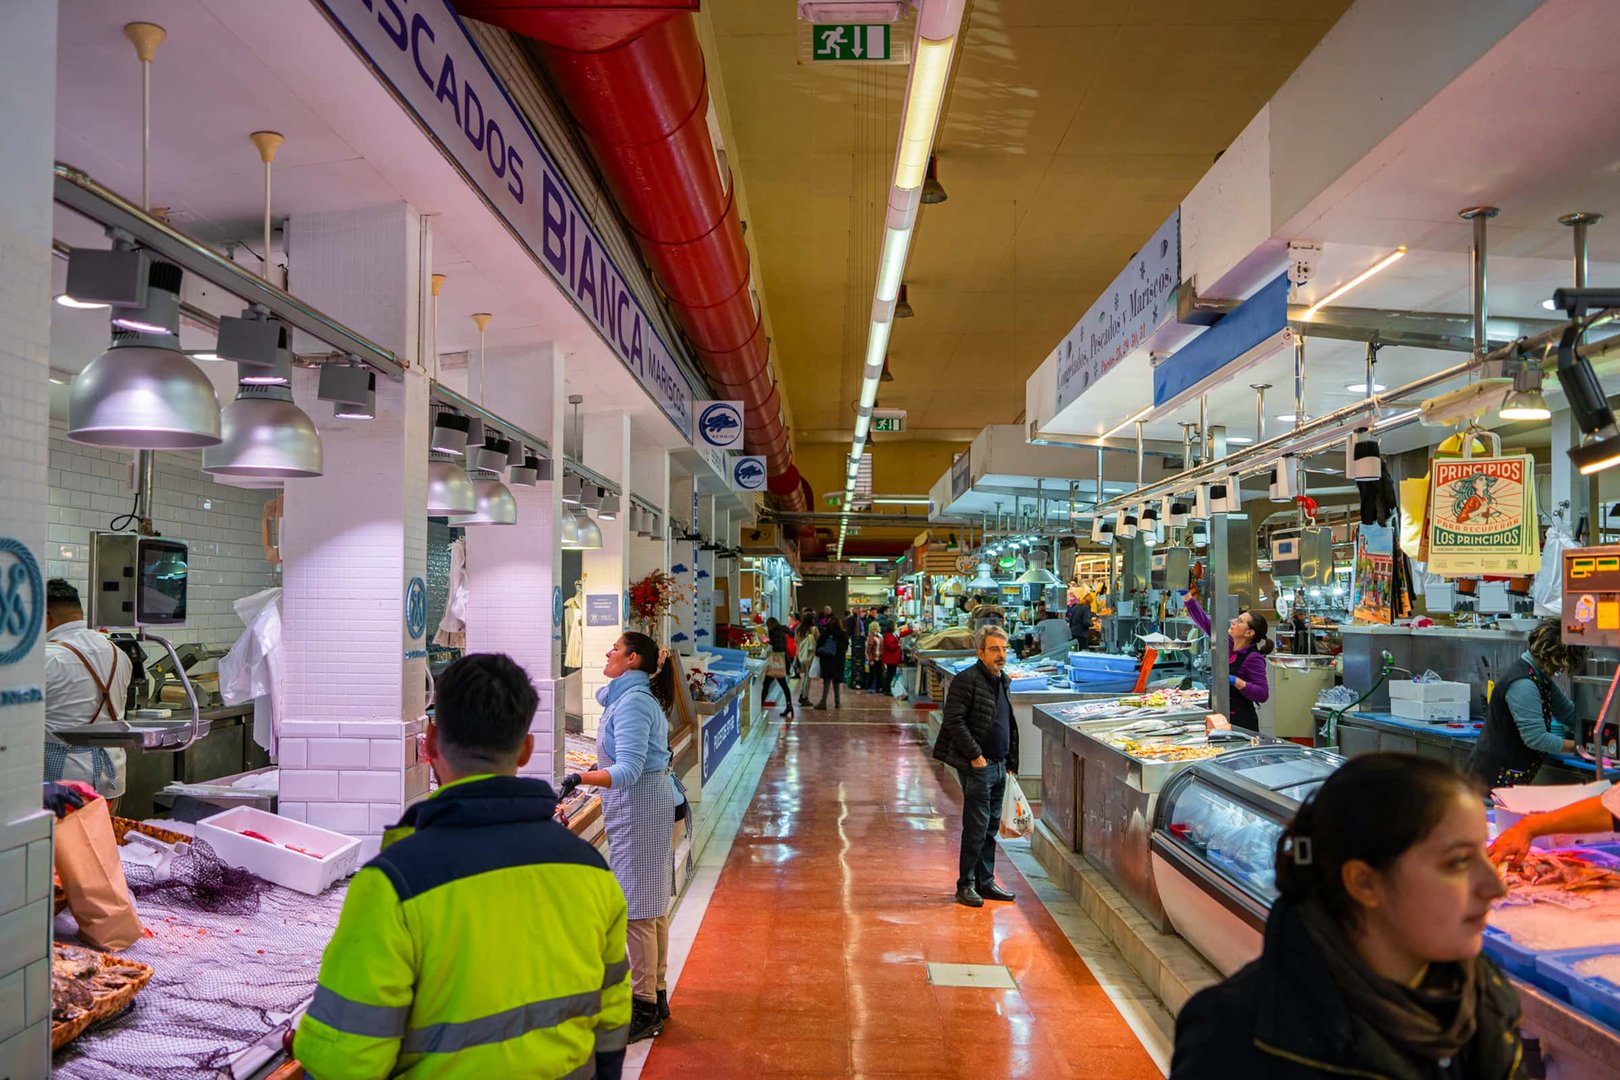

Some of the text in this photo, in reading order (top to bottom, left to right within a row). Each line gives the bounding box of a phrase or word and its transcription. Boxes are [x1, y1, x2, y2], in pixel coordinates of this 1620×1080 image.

[361, 0, 686, 416] SCADOS BIANCA MARISCOS
[1090, 314, 1121, 359] Pescados
[1440, 463, 1520, 484] PRINCIPIOS
[1436, 517, 1519, 533] PARA RECUPERAR
[1436, 529, 1519, 545] LOS PRINCIPIOS
